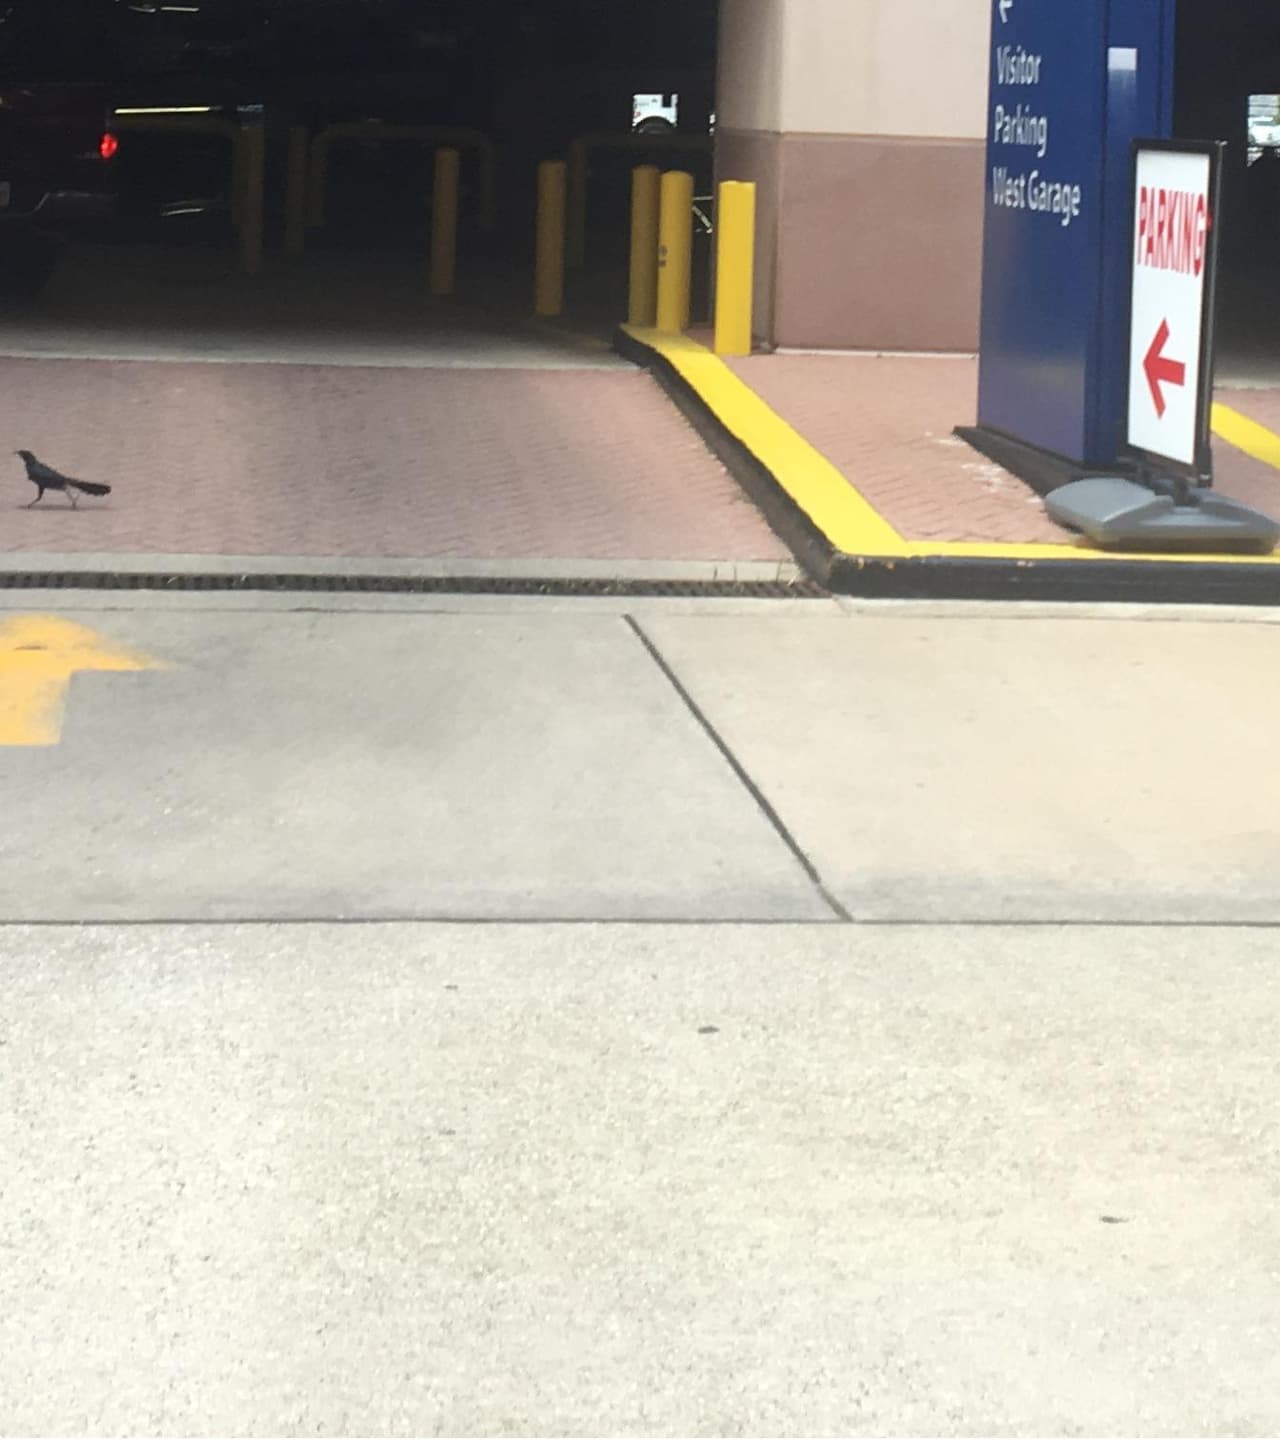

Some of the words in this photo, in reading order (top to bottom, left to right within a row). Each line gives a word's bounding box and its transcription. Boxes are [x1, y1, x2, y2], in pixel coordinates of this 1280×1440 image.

[996, 45, 1042, 86] Visitor
[994, 104, 1048, 159] Parking
[992, 166, 1026, 209] West
[1027, 169, 1081, 228] Garage
[1137, 185, 1205, 277] PARKING
